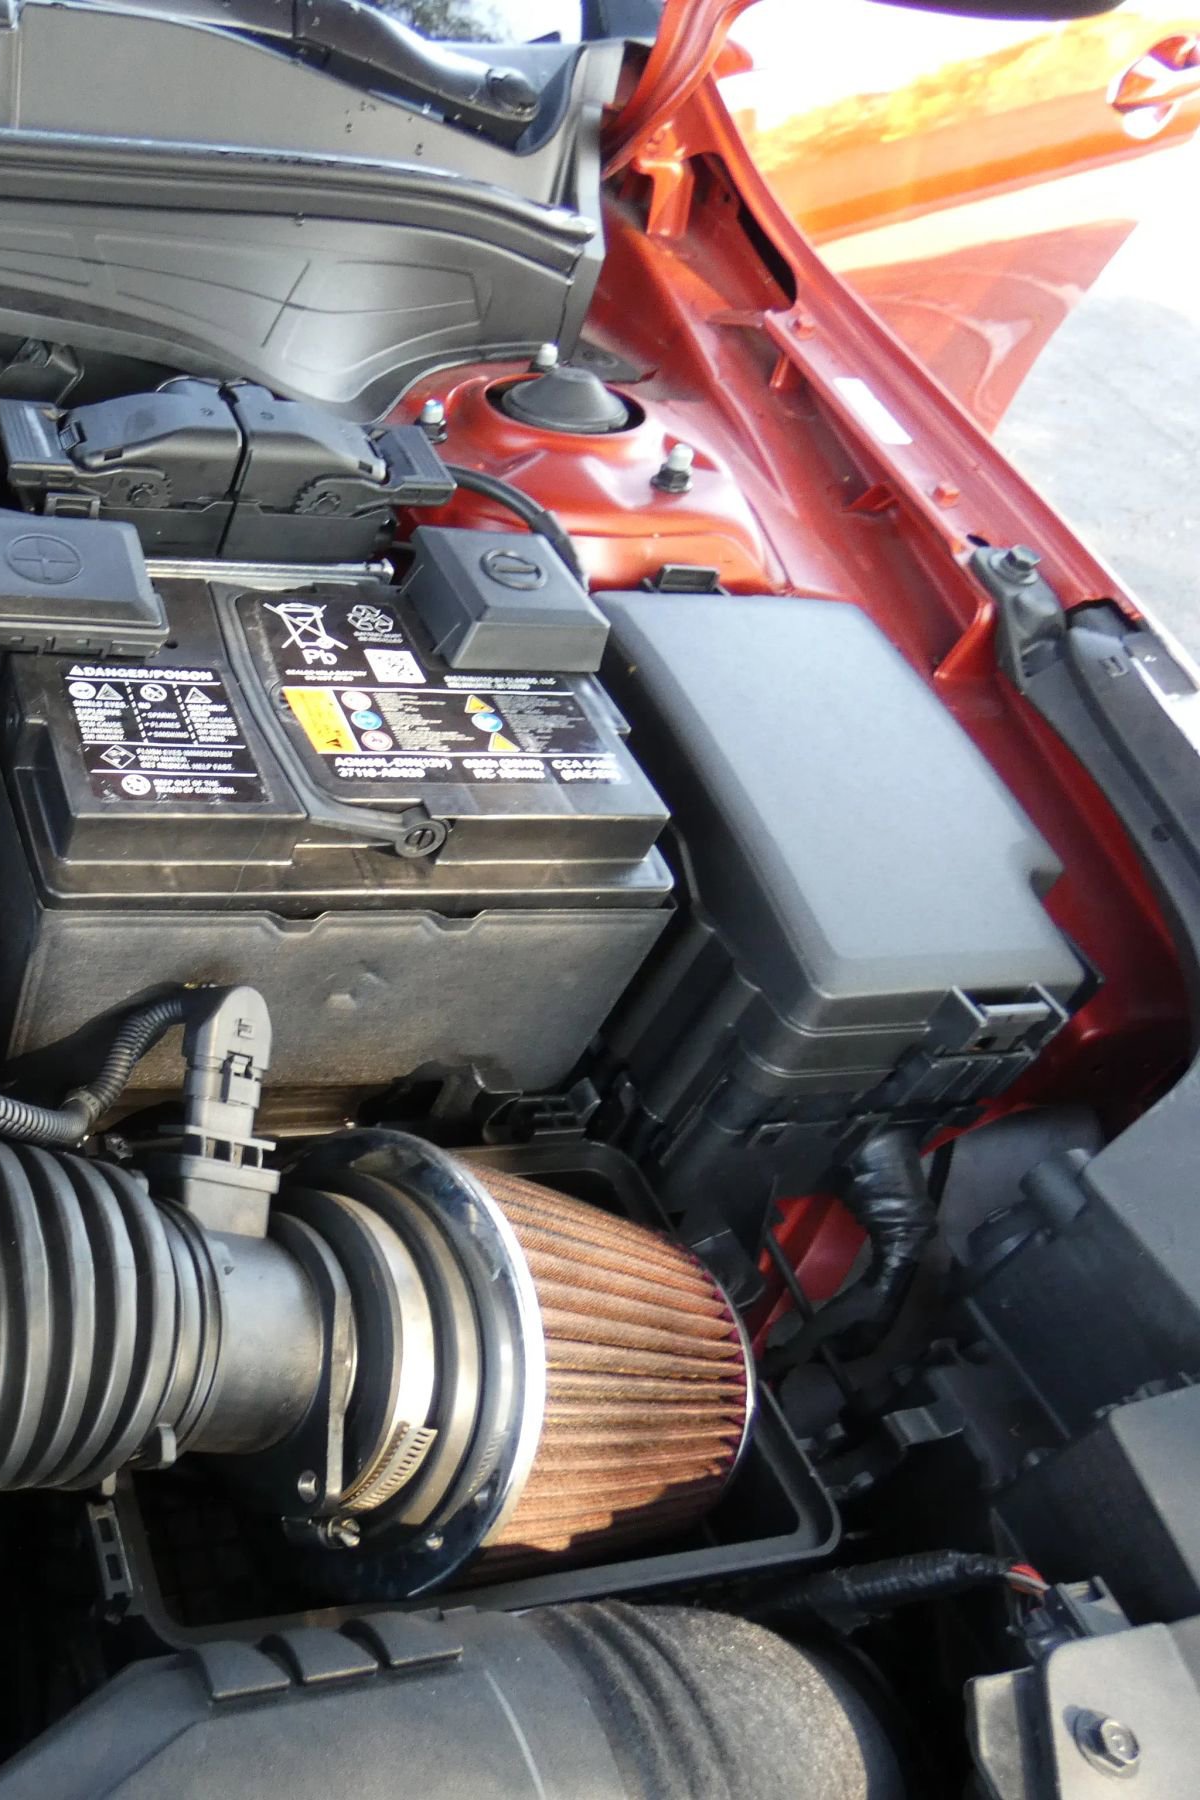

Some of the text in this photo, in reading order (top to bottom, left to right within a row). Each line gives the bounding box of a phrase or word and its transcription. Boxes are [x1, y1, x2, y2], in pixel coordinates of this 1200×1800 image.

[302, 649, 337, 665] Pb
[84, 667, 213, 680] DANGER/POISON
[552, 760, 583, 768] CCA
